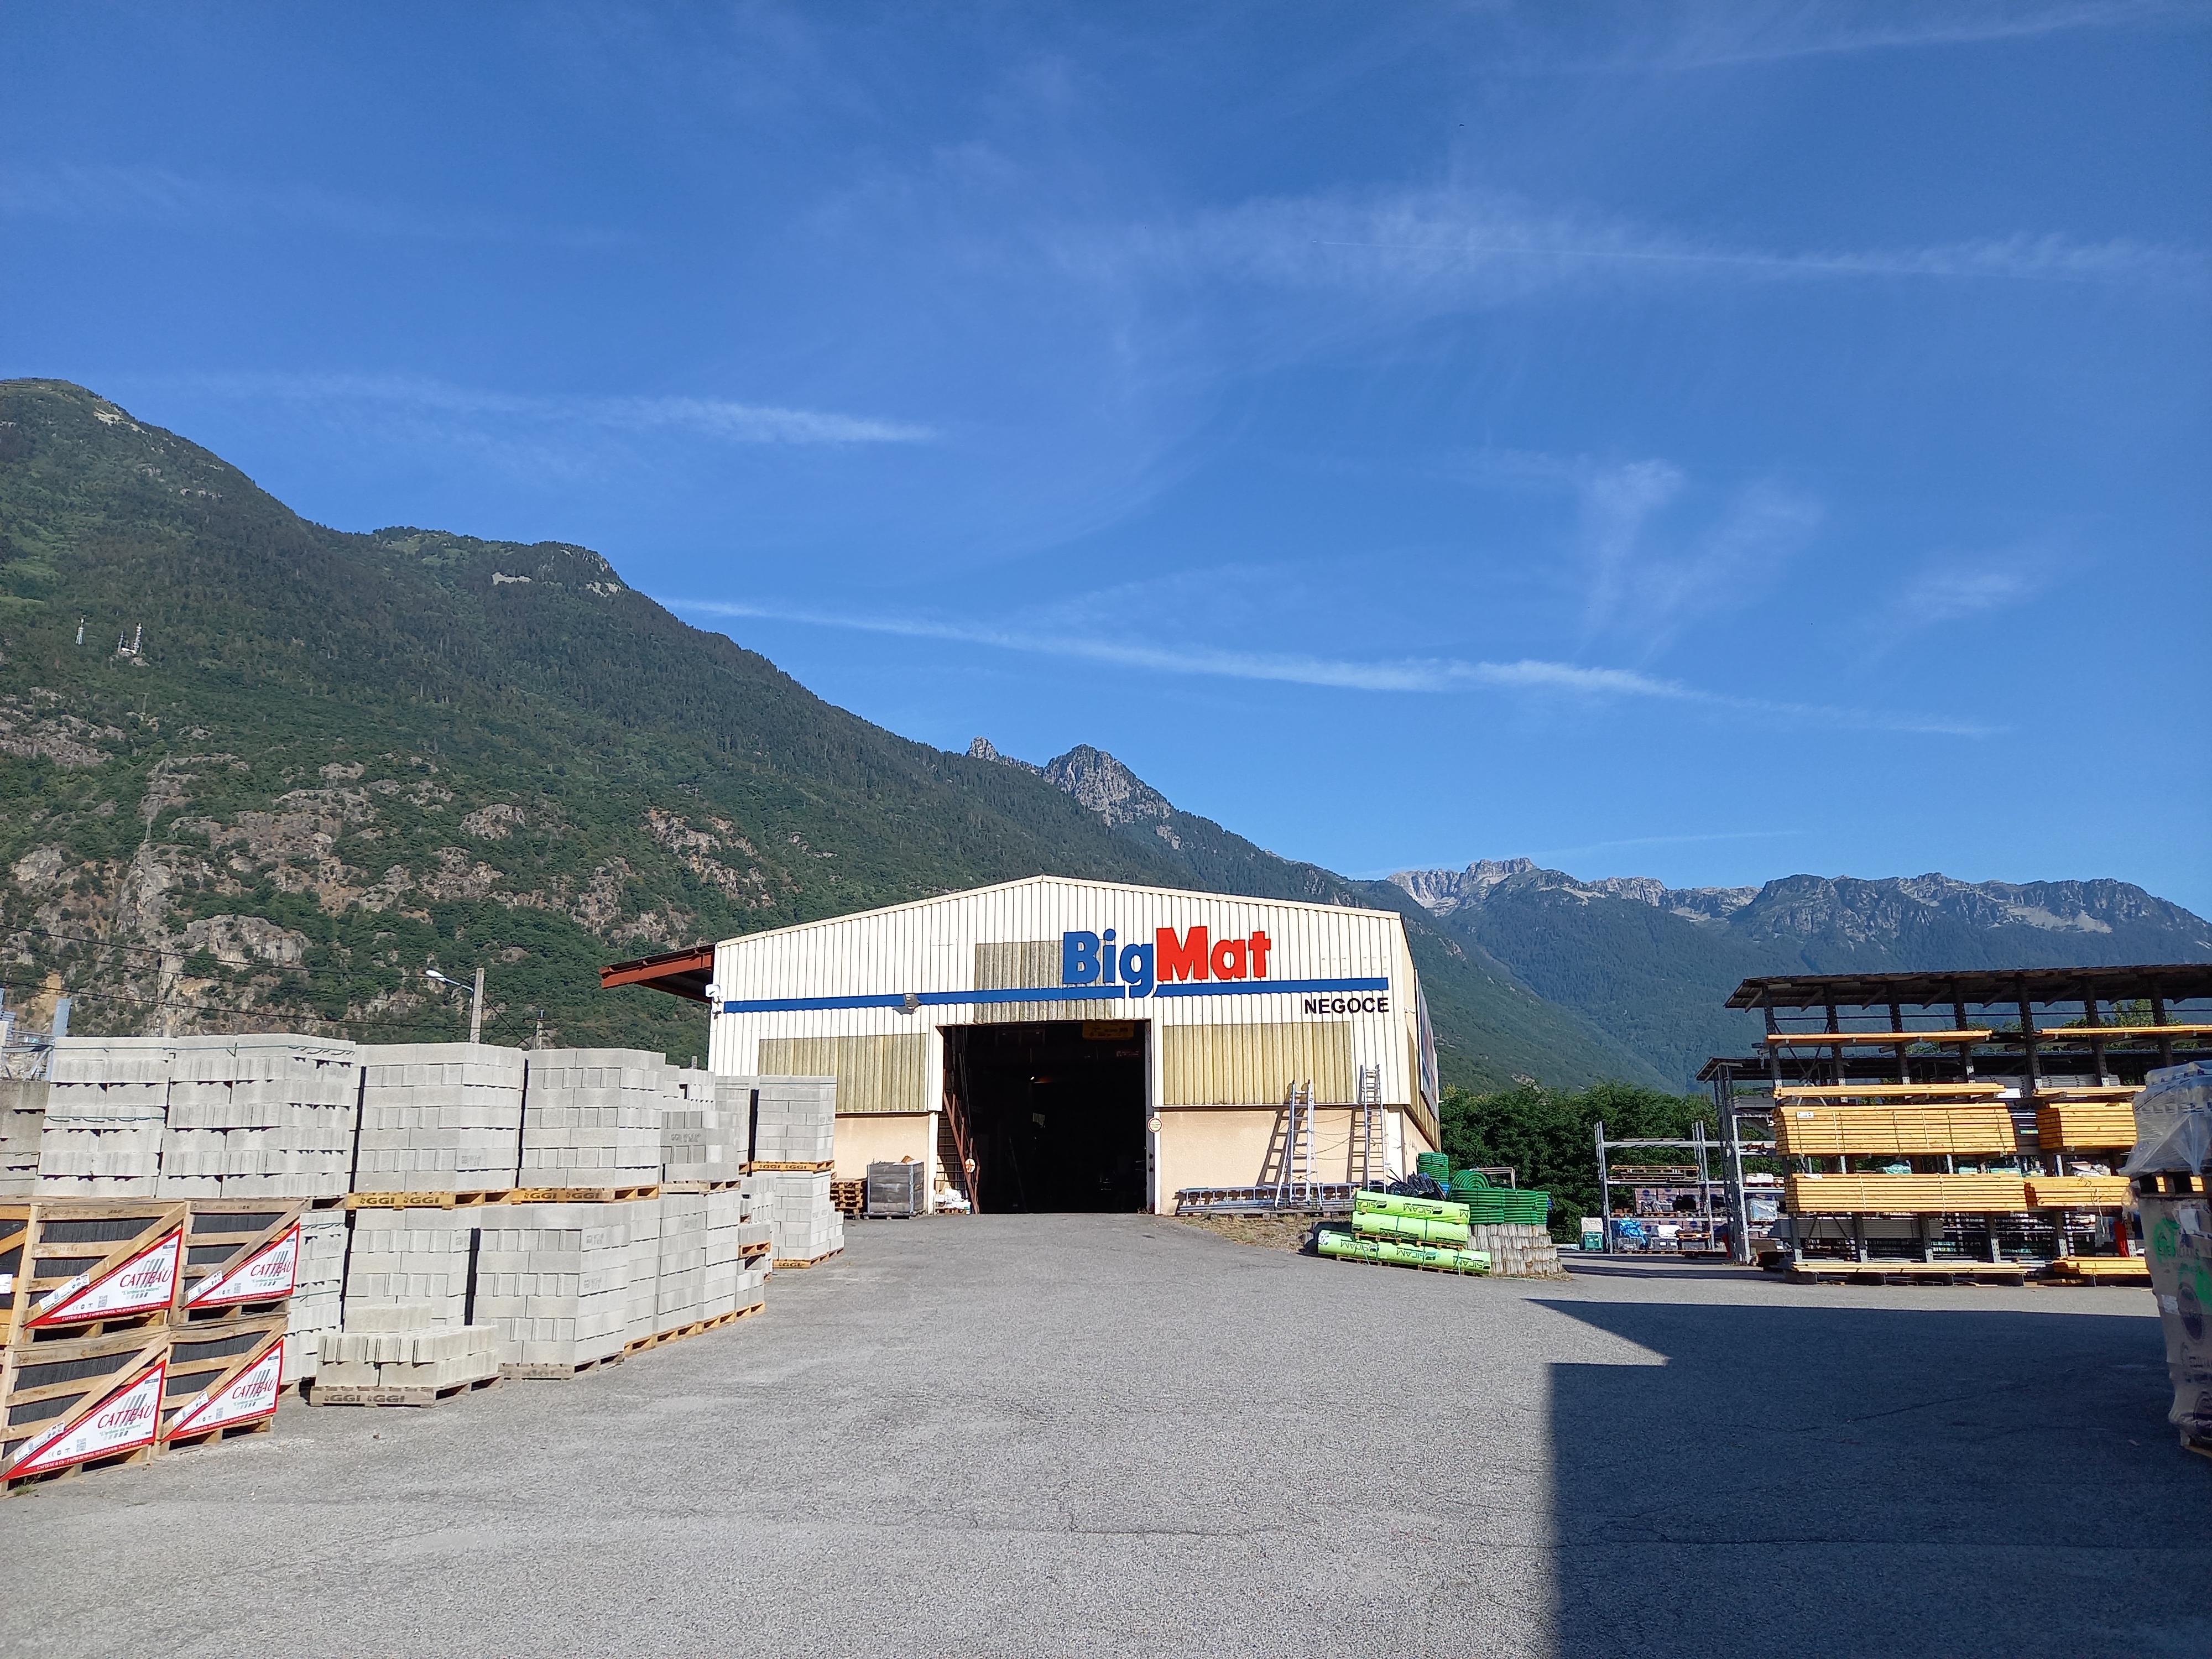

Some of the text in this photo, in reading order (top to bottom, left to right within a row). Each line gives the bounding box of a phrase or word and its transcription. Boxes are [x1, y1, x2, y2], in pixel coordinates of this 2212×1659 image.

[1062, 926, 1271, 998] BigMat
[1305, 997, 1389, 1015] NEGOCE
[1404, 1204, 1432, 1214] SICAM
[1340, 1241, 1369, 1251] SICAM
[1396, 1249, 1424, 1259] SICAM
[250, 1261, 294, 1276] CATTEAU
[120, 1269, 173, 1287] CATTEAU
[232, 1378, 276, 1399] CATTEAU
[97, 1404, 155, 1429] CATTEAU
